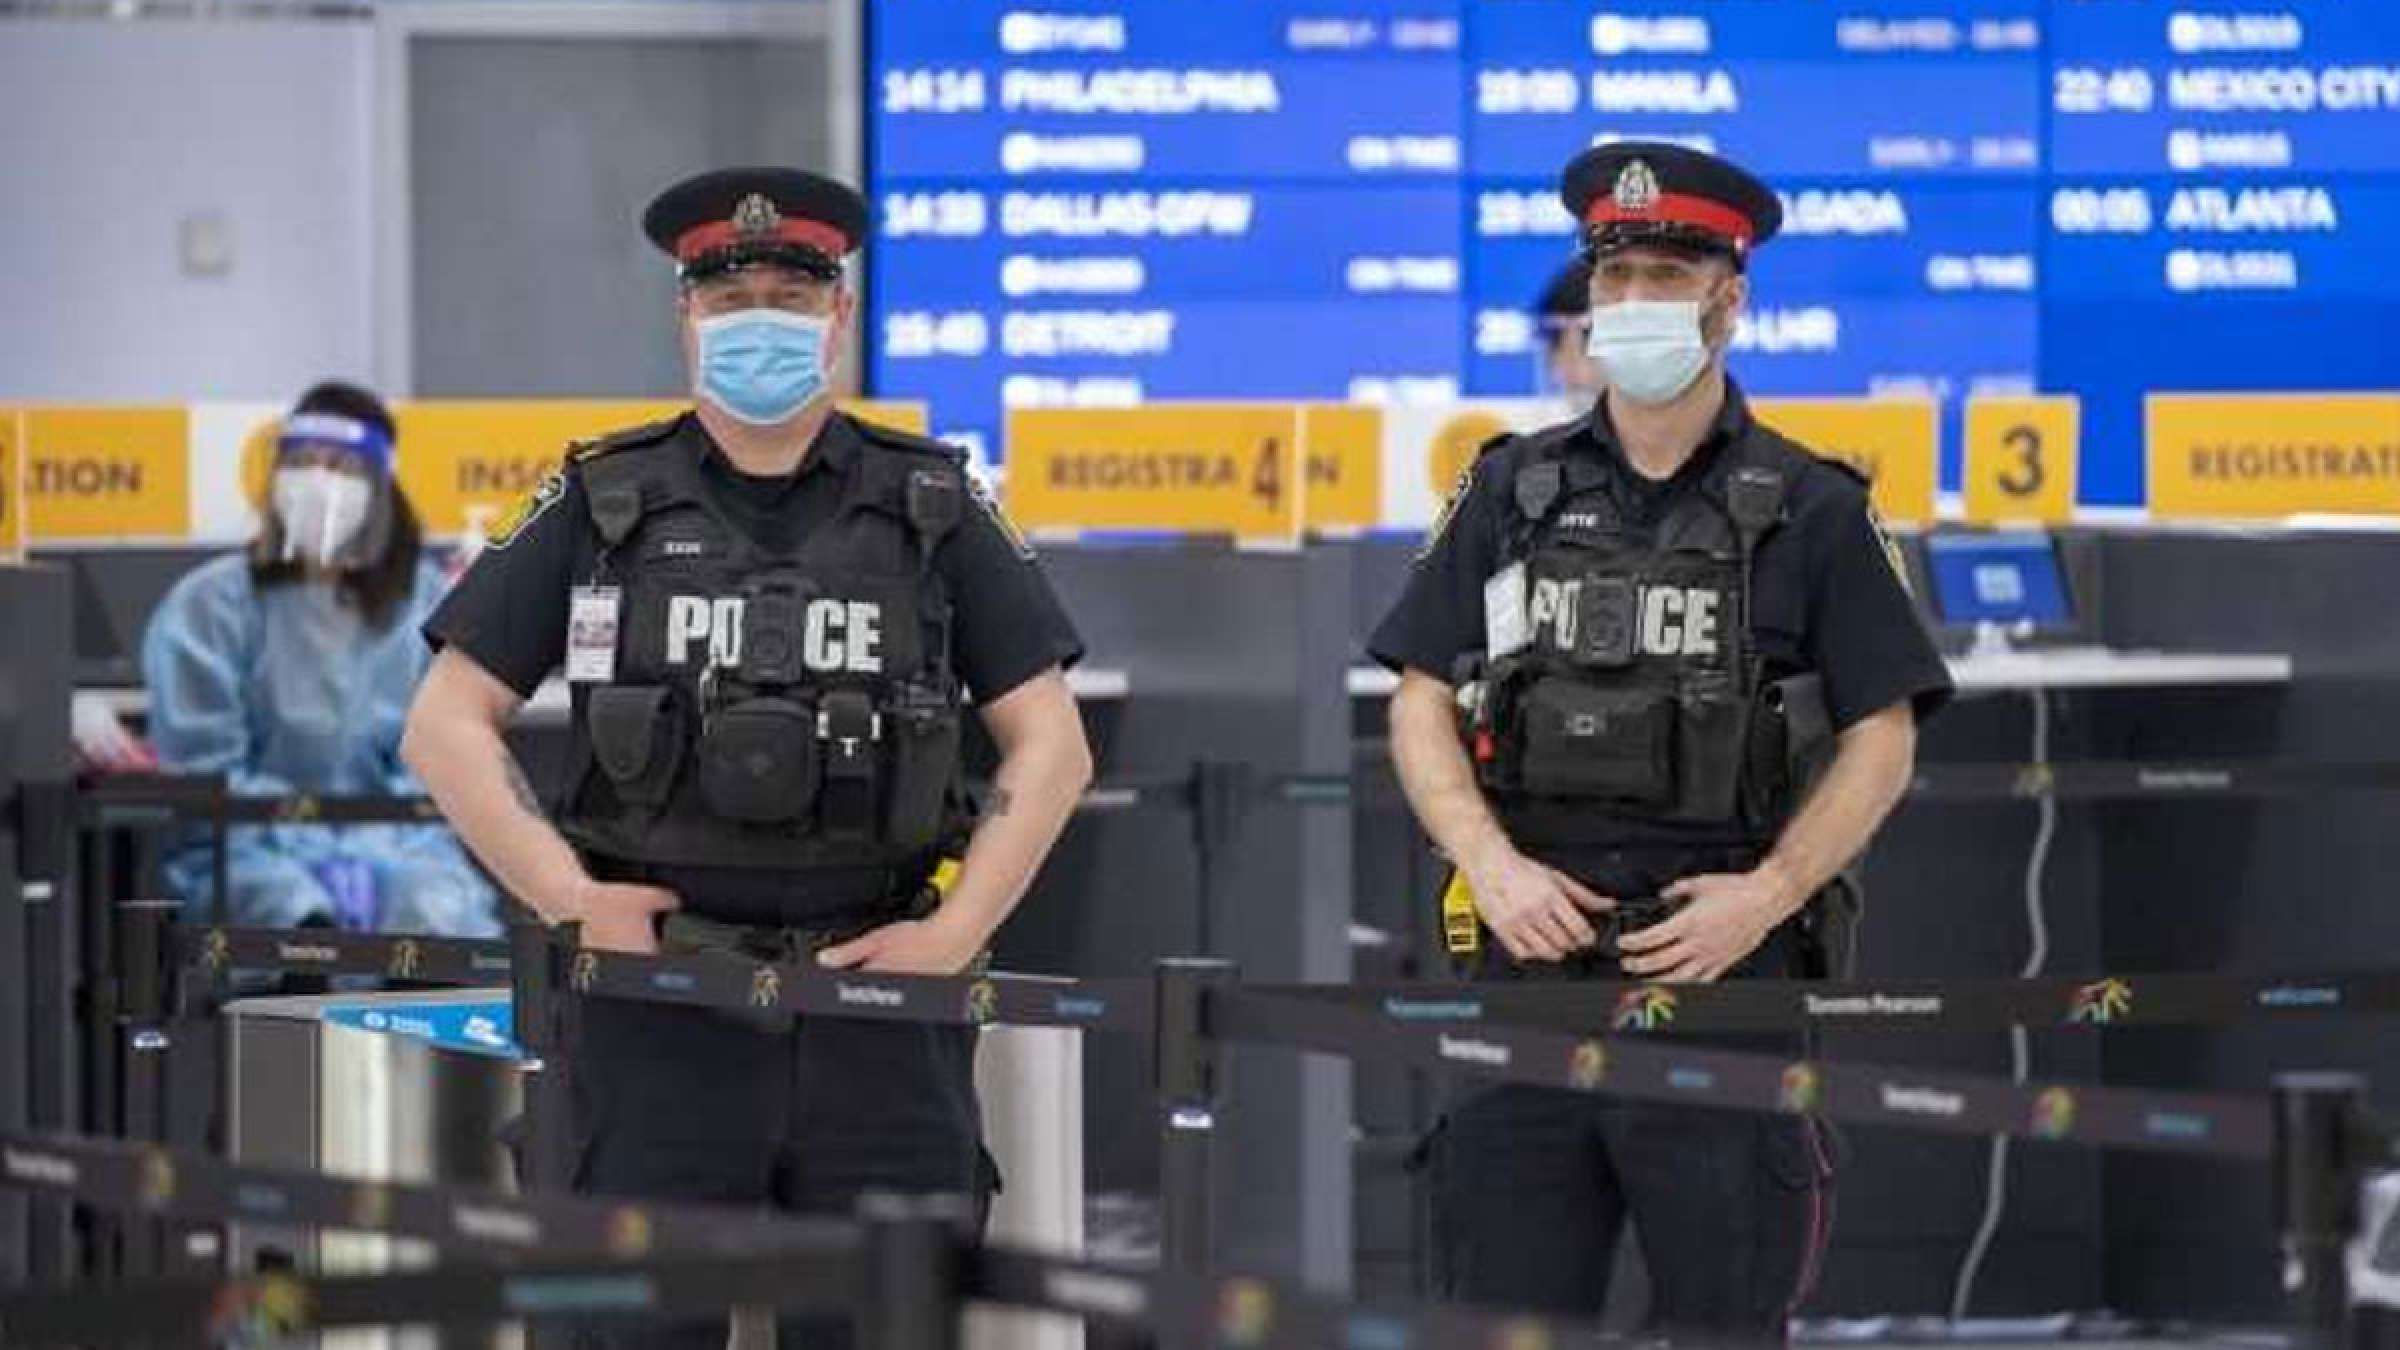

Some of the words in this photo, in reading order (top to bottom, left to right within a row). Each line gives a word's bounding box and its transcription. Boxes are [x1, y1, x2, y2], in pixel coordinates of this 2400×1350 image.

[1003, 71, 1276, 111] PHILADELPHIA
[1591, 72, 1736, 112] MANILA
[2169, 72, 2315, 109] MEXICO
[2319, 70, 2400, 109] CITY
[2165, 189, 2336, 231] ATLANTA
[1003, 311, 1175, 354] DETROIT
[32, 458, 144, 495] TION
[1252, 437, 1280, 514] 4
[1997, 425, 2044, 496] 3
[664, 594, 884, 675] POCE
